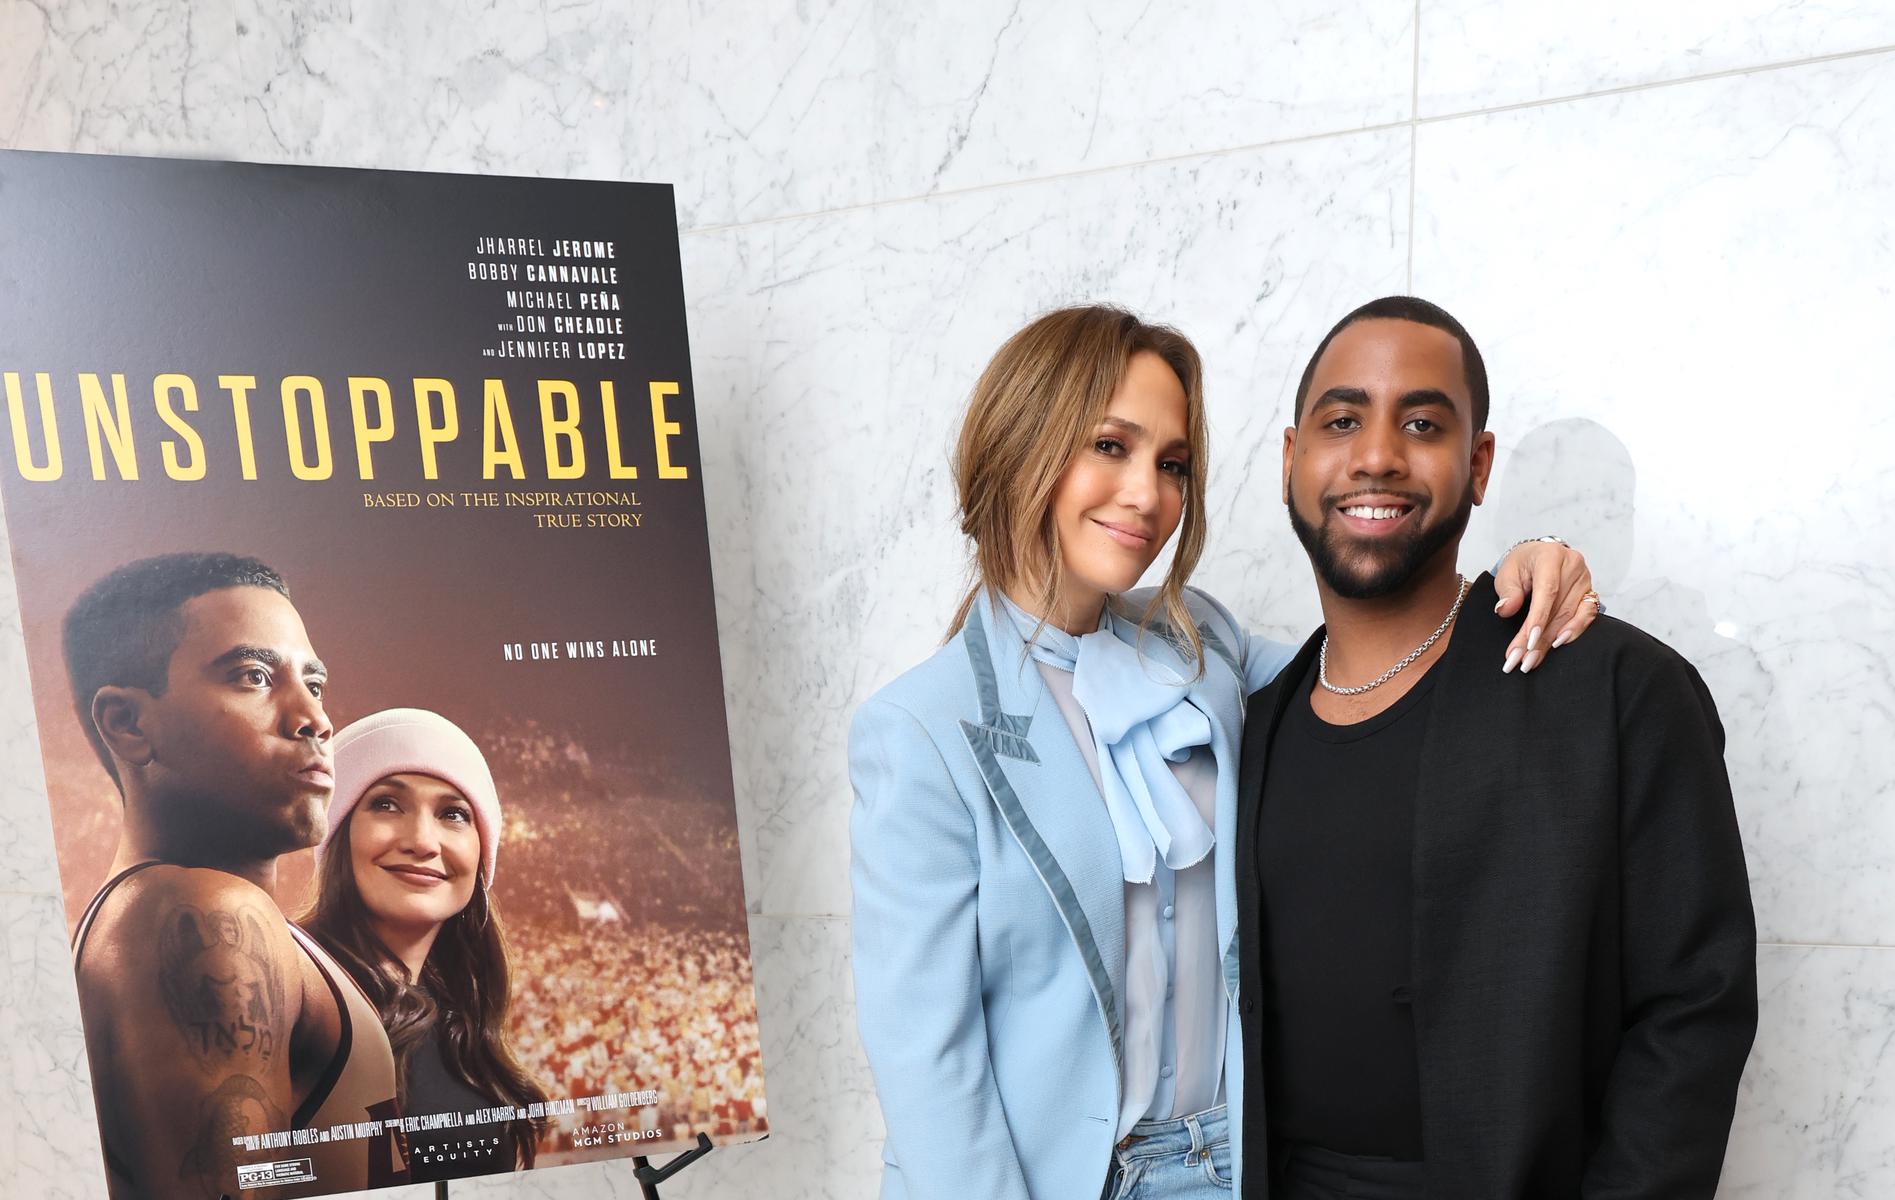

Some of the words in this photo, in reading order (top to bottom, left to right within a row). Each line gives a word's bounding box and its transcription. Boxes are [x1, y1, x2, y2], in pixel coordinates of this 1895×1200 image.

[476, 237, 544, 256] JHARREL
[552, 240, 614, 258] JEROME
[468, 263, 517, 280] BOBBY
[526, 265, 617, 284] CANNAVALE
[507, 291, 572, 310] MICHAEL
[580, 291, 620, 310] PEÑA
[498, 323, 513, 331] WITH
[517, 316, 546, 333] DON
[554, 316, 623, 334] CHEADLE
[498, 341, 570, 359] JENNIFER
[578, 342, 625, 359] LOPEZ
[3, 372, 689, 482] UNSTOPPABLE
[364, 493, 420, 508] BASED
[427, 493, 454, 507] ON
[460, 492, 500, 507] THE
[506, 492, 641, 506] INSPIRATIONAL
[534, 514, 582, 528] TRUE
[587, 514, 643, 528] STORY
[503, 643, 523, 661] NO
[532, 642, 559, 660] ONE
[566, 641, 604, 658] WINS
[612, 639, 657, 657] ALONE
[261, 1131, 291, 1149] ANTHONY
[292, 1128, 319, 1145] ROBLES
[320, 1131, 330, 1142] AND
[330, 1123, 354, 1141] AUSTIN
[354, 1121, 383, 1138] MURPHY
[405, 1116, 420, 1132] ERIC
[465, 1114, 475, 1126] AND
[476, 1108, 491, 1124] ALEX
[491, 1106, 515, 1122] HARRIS
[517, 1108, 527, 1119] AND
[528, 1102, 544, 1119] JOHN
[590, 1094, 618, 1111] WILLIAM
[572, 1122, 625, 1137] AMAZON
[415, 1138, 499, 1154] ARTISTS
[574, 1136, 602, 1148] MGM
[608, 1129, 662, 1144] STUDIOS
[424, 1149, 493, 1163] EQUITY
[240, 1170, 272, 1182] PG-13
